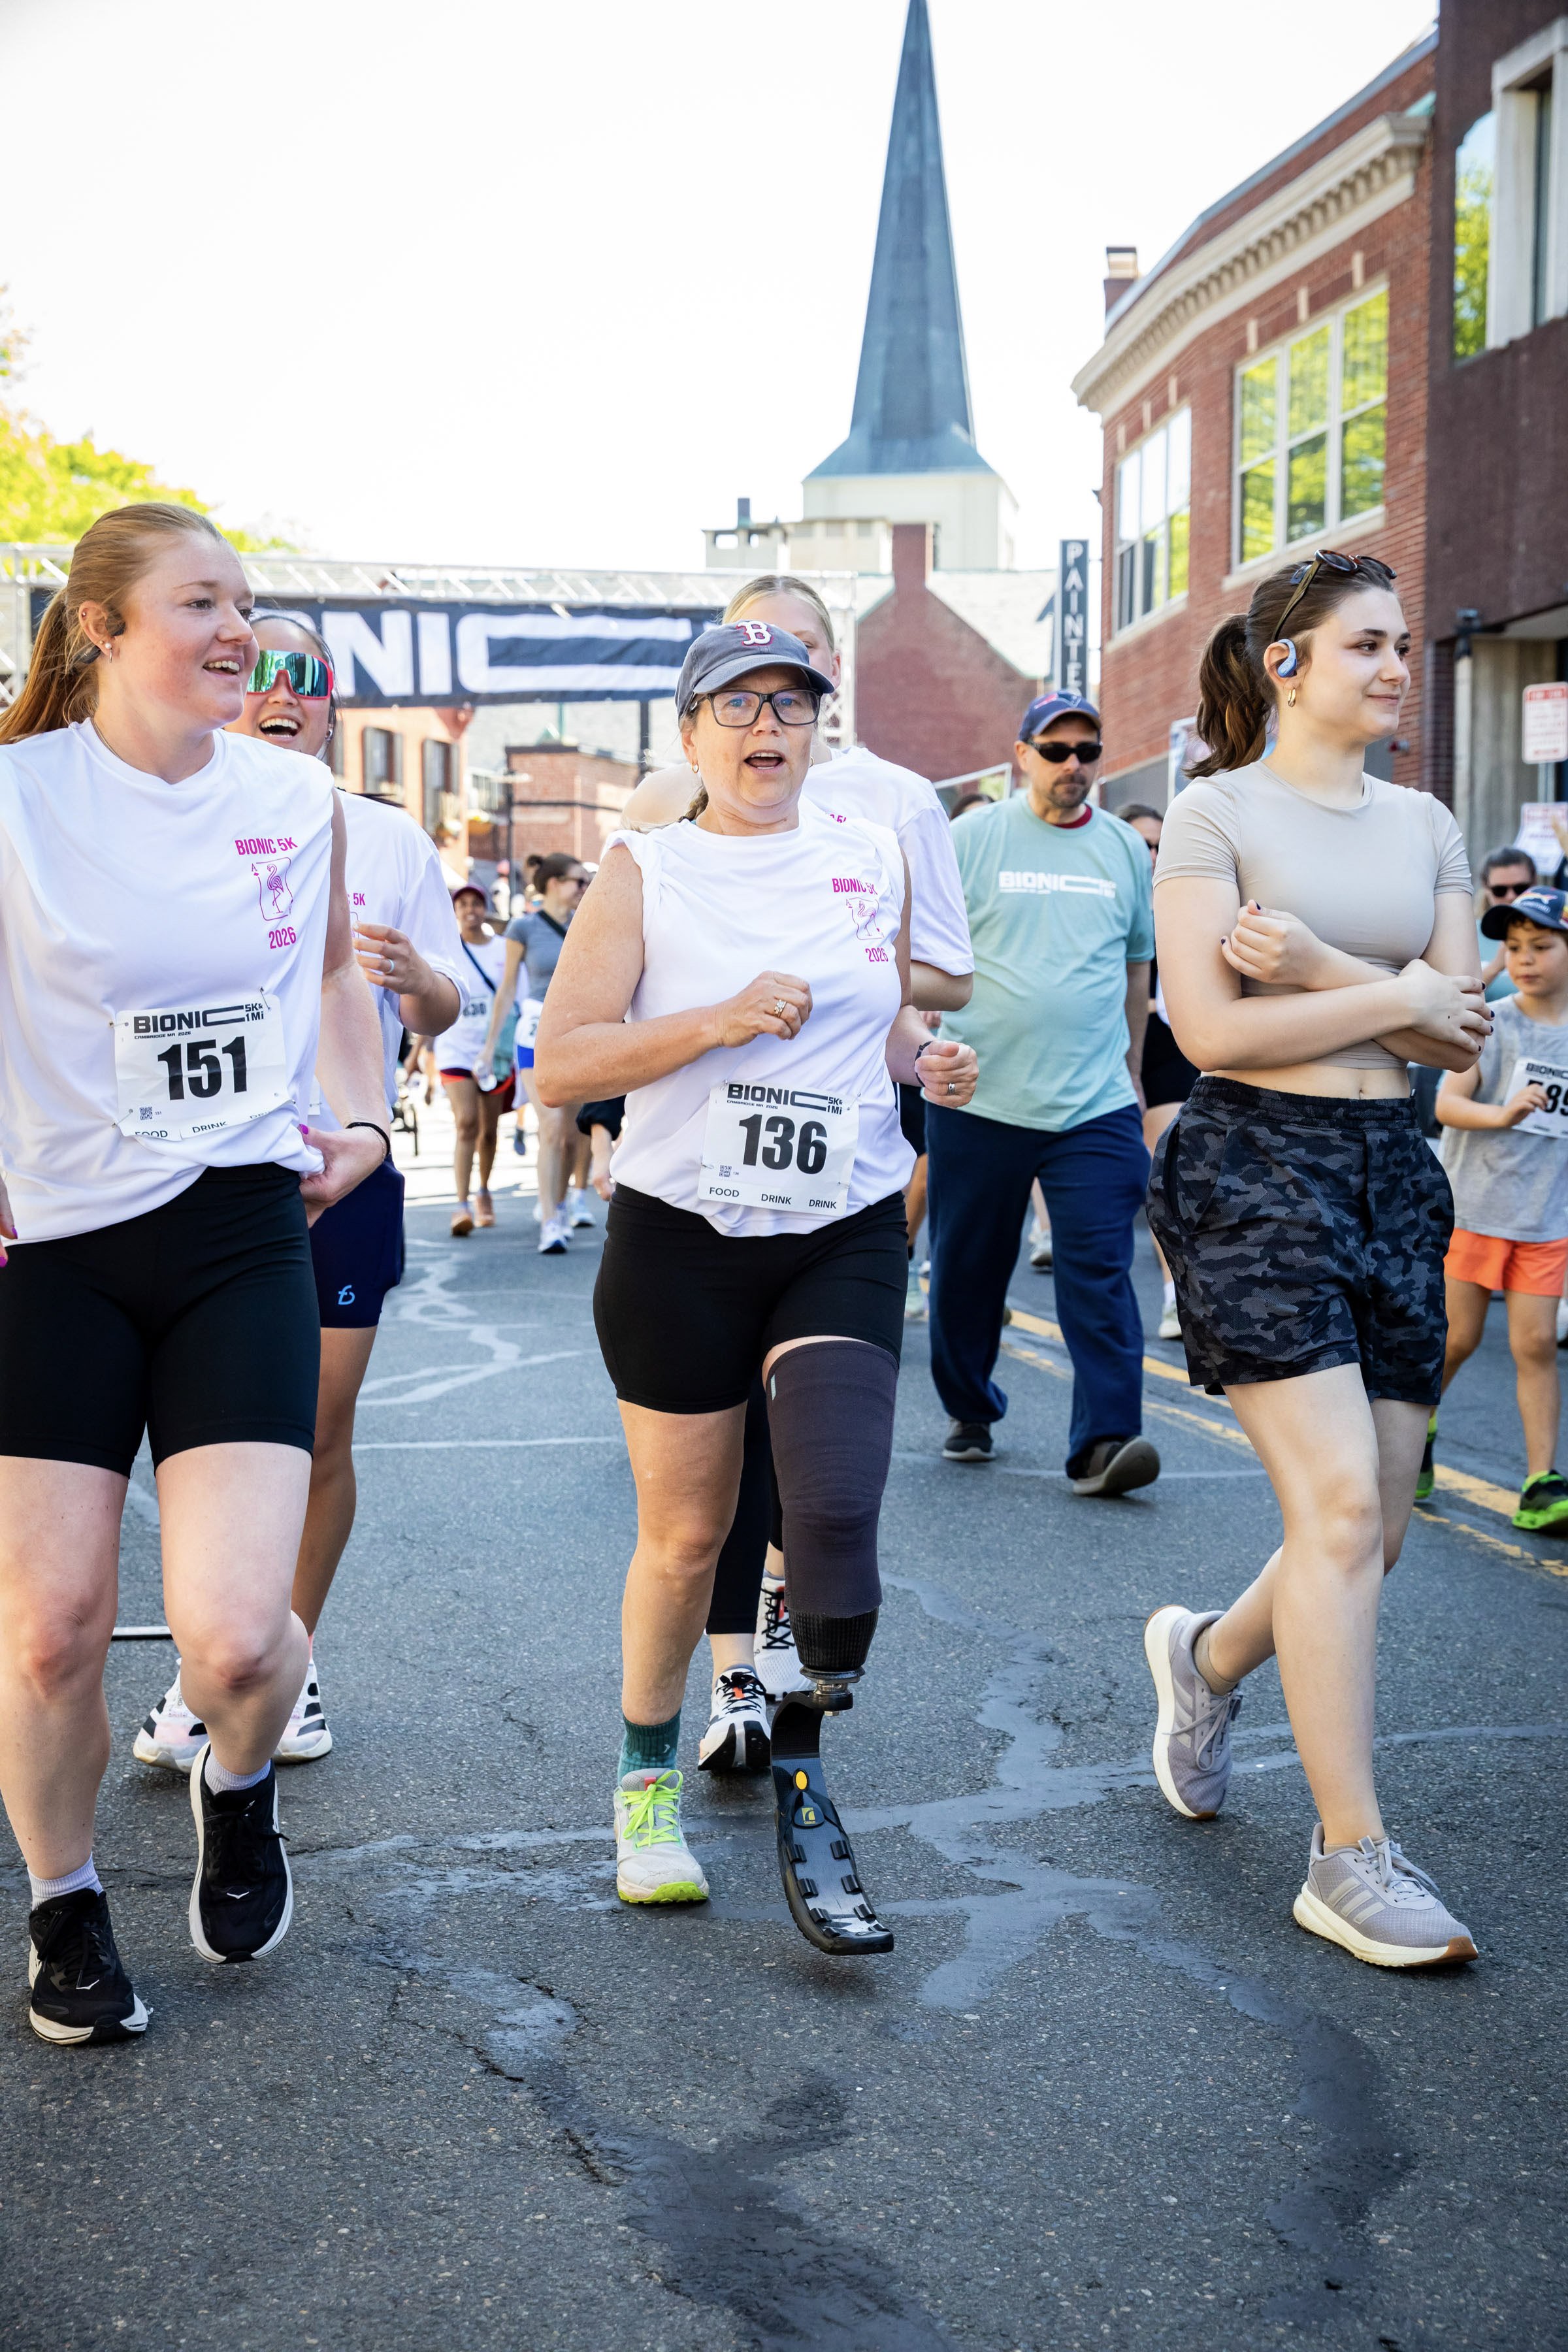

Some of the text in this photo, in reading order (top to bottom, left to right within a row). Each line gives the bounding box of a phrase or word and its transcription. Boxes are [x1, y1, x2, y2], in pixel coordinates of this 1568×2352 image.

[736, 621, 774, 646] B
[235, 837, 298, 855] BIONIC 5K
[832, 878, 866, 893] BIONIC
[999, 871, 1102, 894] BIONIC
[353, 893, 365, 906] 5K
[269, 926, 297, 949] 2026
[865, 947, 889, 962] 2026
[134, 1005, 245, 1034] BIONIC
[157, 1036, 247, 1101] 151
[1526, 1062, 1568, 1079] BIONI
[727, 1084, 828, 1111] BIONIC
[192, 1121, 228, 1133] DRINK
[739, 1113, 828, 1175] 136
[709, 1186, 837, 1209] FOOD DRINK DRINK
